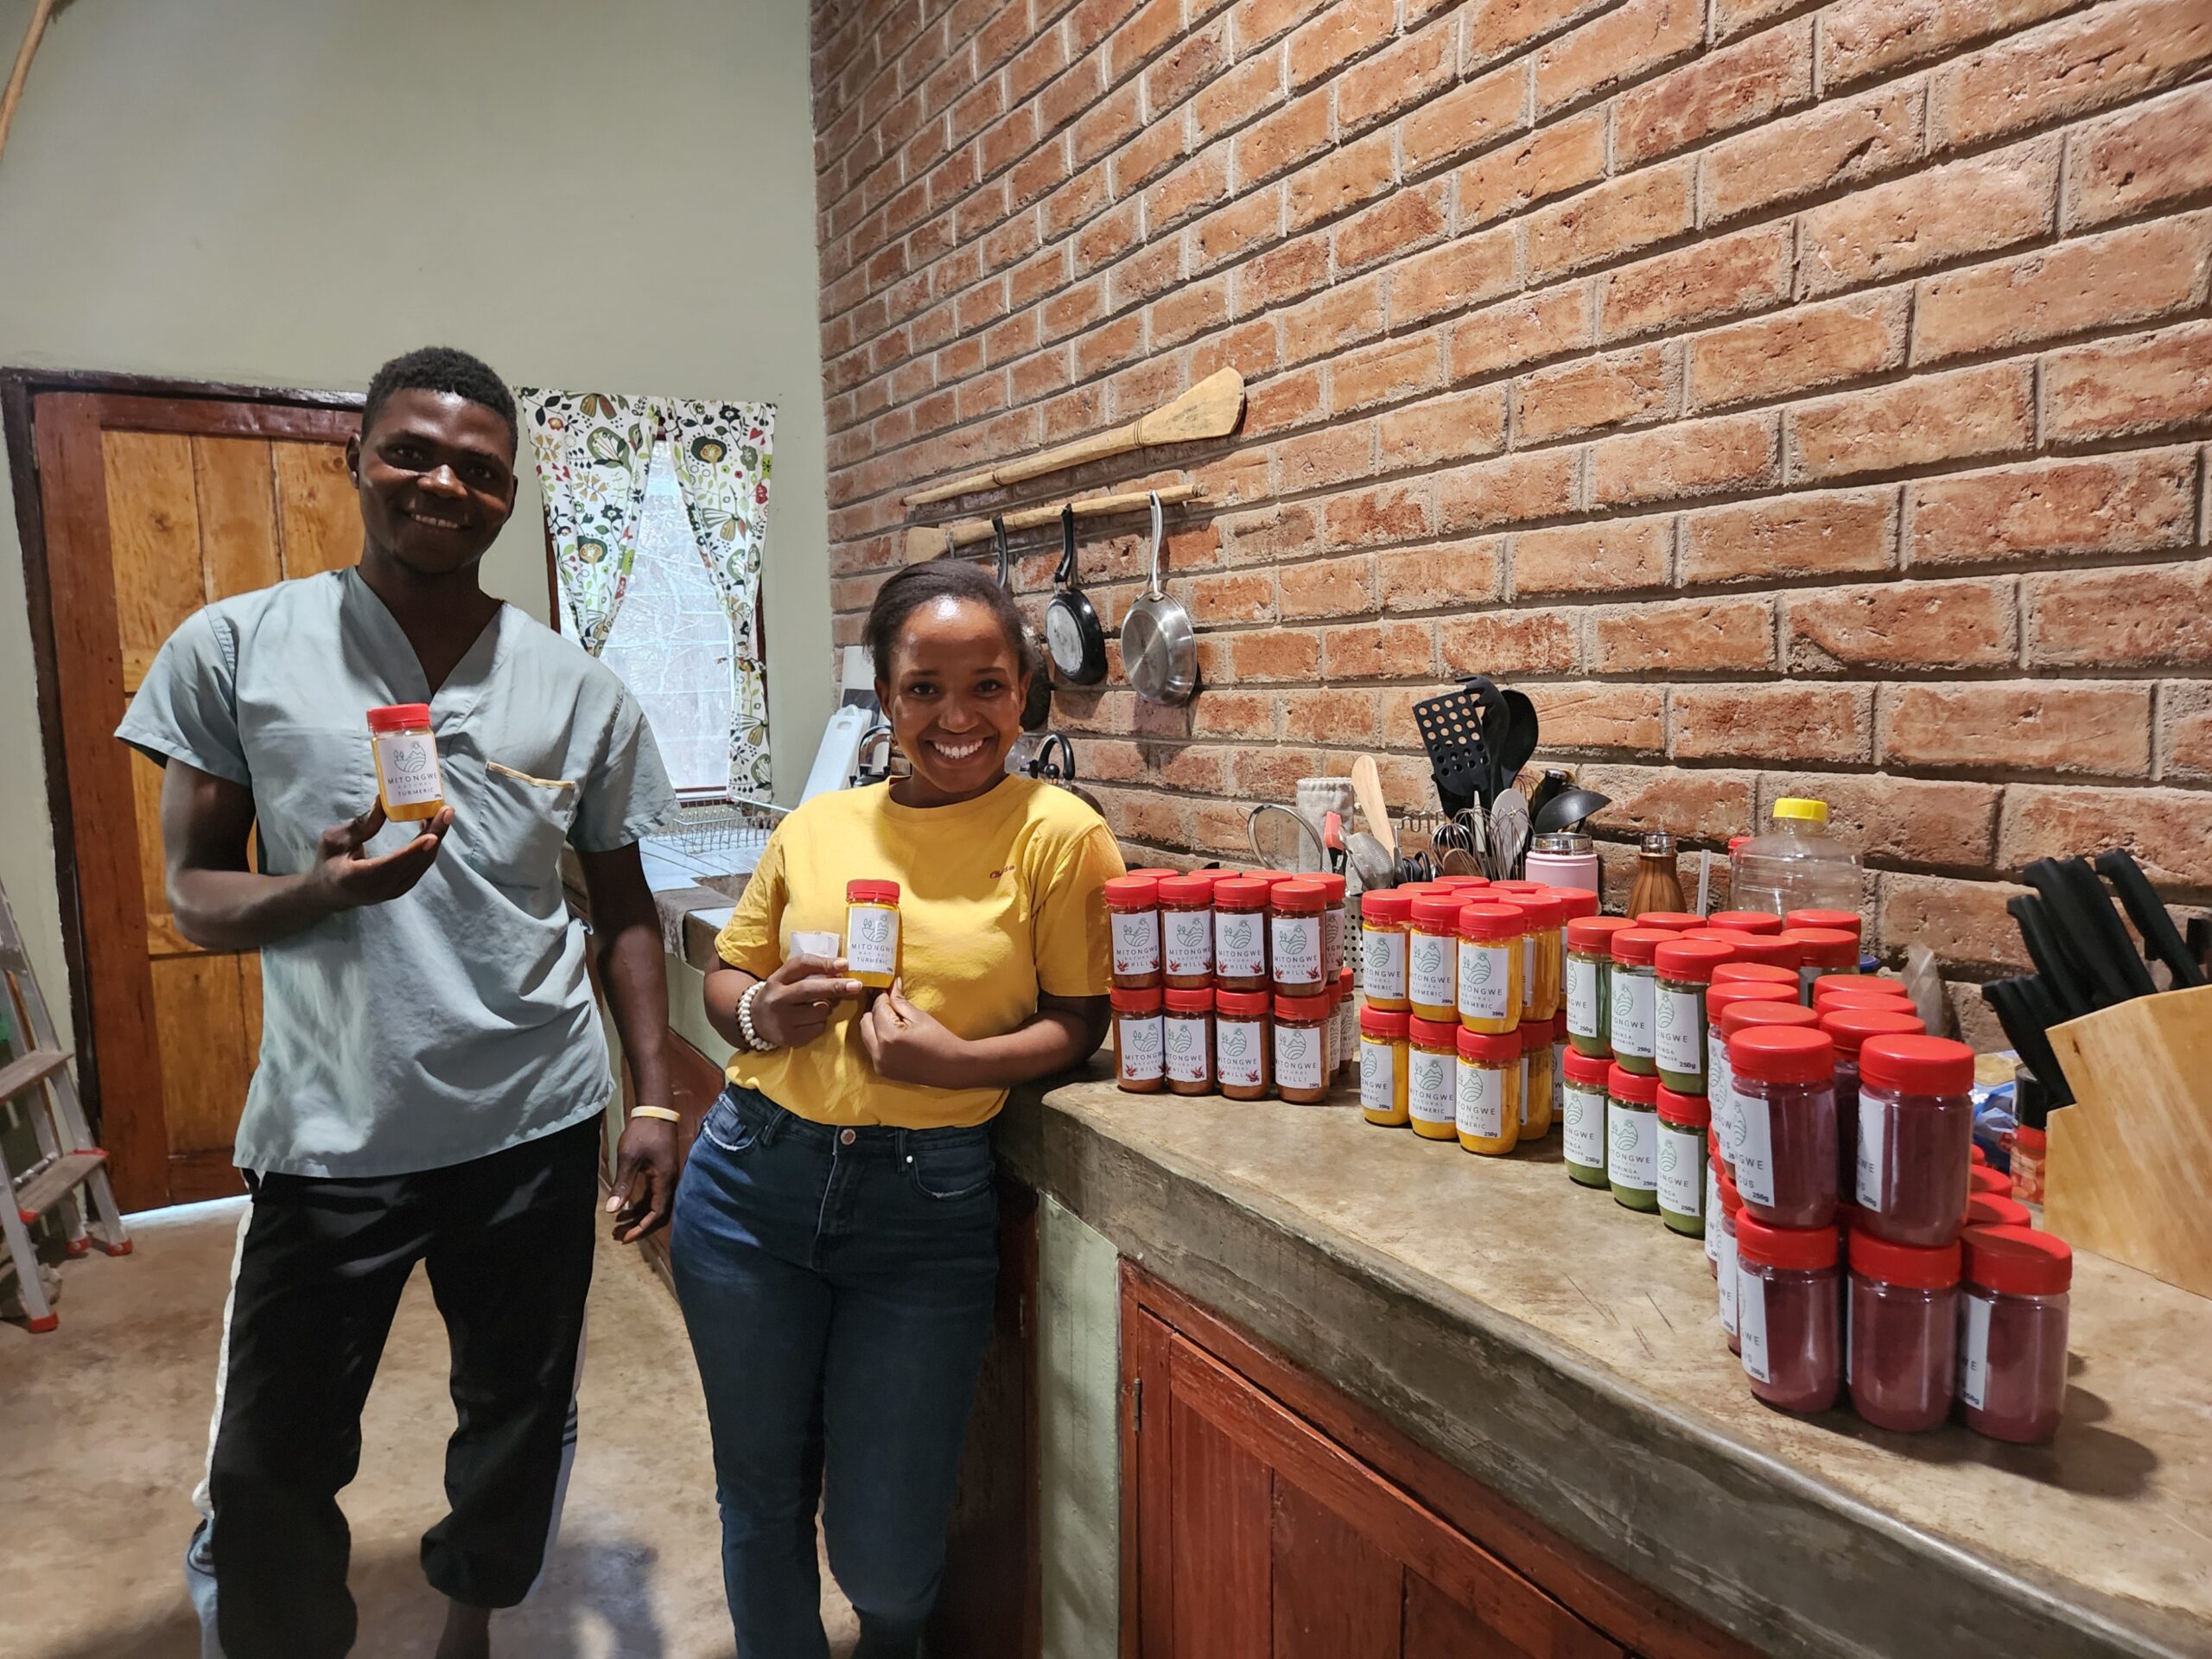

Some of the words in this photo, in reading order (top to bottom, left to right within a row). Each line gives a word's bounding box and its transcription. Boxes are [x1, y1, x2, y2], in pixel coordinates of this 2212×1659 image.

[387, 772, 438, 785] MITONGWE
[397, 787, 435, 798] TURMERIC
[851, 943, 894, 955] MITONGWE
[1116, 944, 1158, 956] MITONGWE
[1168, 945, 1211, 956] MITONGWE
[1218, 949, 1262, 957] MITONGWE
[857, 957, 889, 965] TURMERIC
[1274, 954, 1318, 963] MITONGWE
[1460, 998, 1493, 1009] TURMERIC
[1125, 1051, 1162, 1060] MITONGW
[1679, 1061, 1696, 1070] 250g
[1279, 1074, 1306, 1083] CHILLI
[1413, 1103, 1446, 1114] TURMERIC
[1611, 1163, 1637, 1174] MORINGA
[1752, 1191, 1769, 1204] 250g
[1681, 1205, 1695, 1213] 250g
